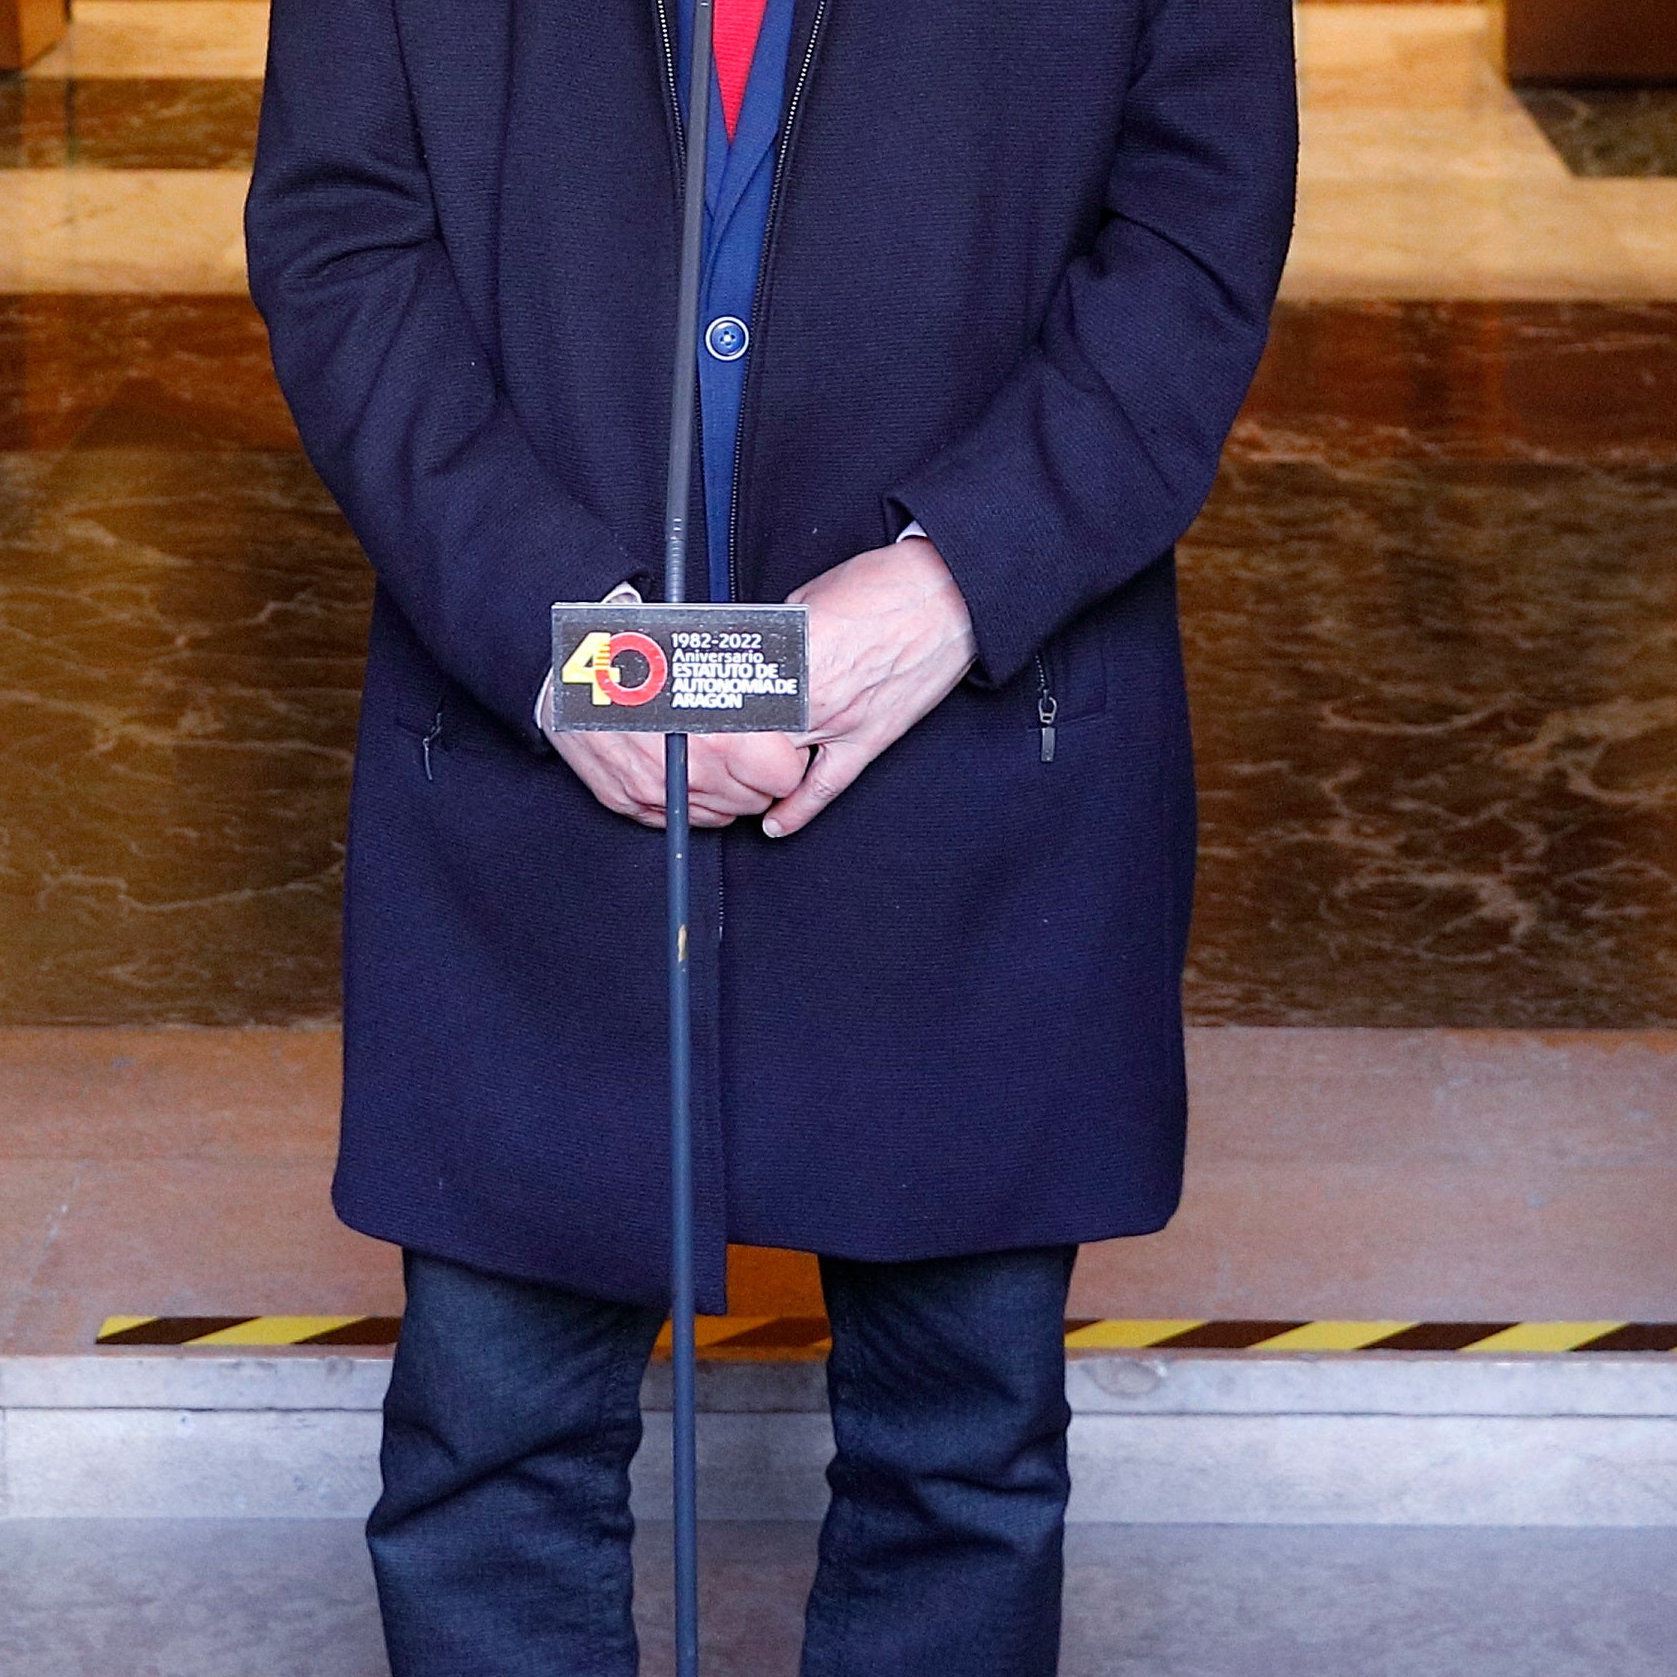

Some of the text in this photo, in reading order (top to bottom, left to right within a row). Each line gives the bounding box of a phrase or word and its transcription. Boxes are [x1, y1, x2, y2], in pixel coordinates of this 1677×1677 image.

[671, 633, 762, 648] 1982-2022
[672, 648, 764, 663] Aniversario
[562, 632, 668, 706] 40
[672, 663, 779, 678] ESTATUTO DE
[775, 678, 798, 694] DE
